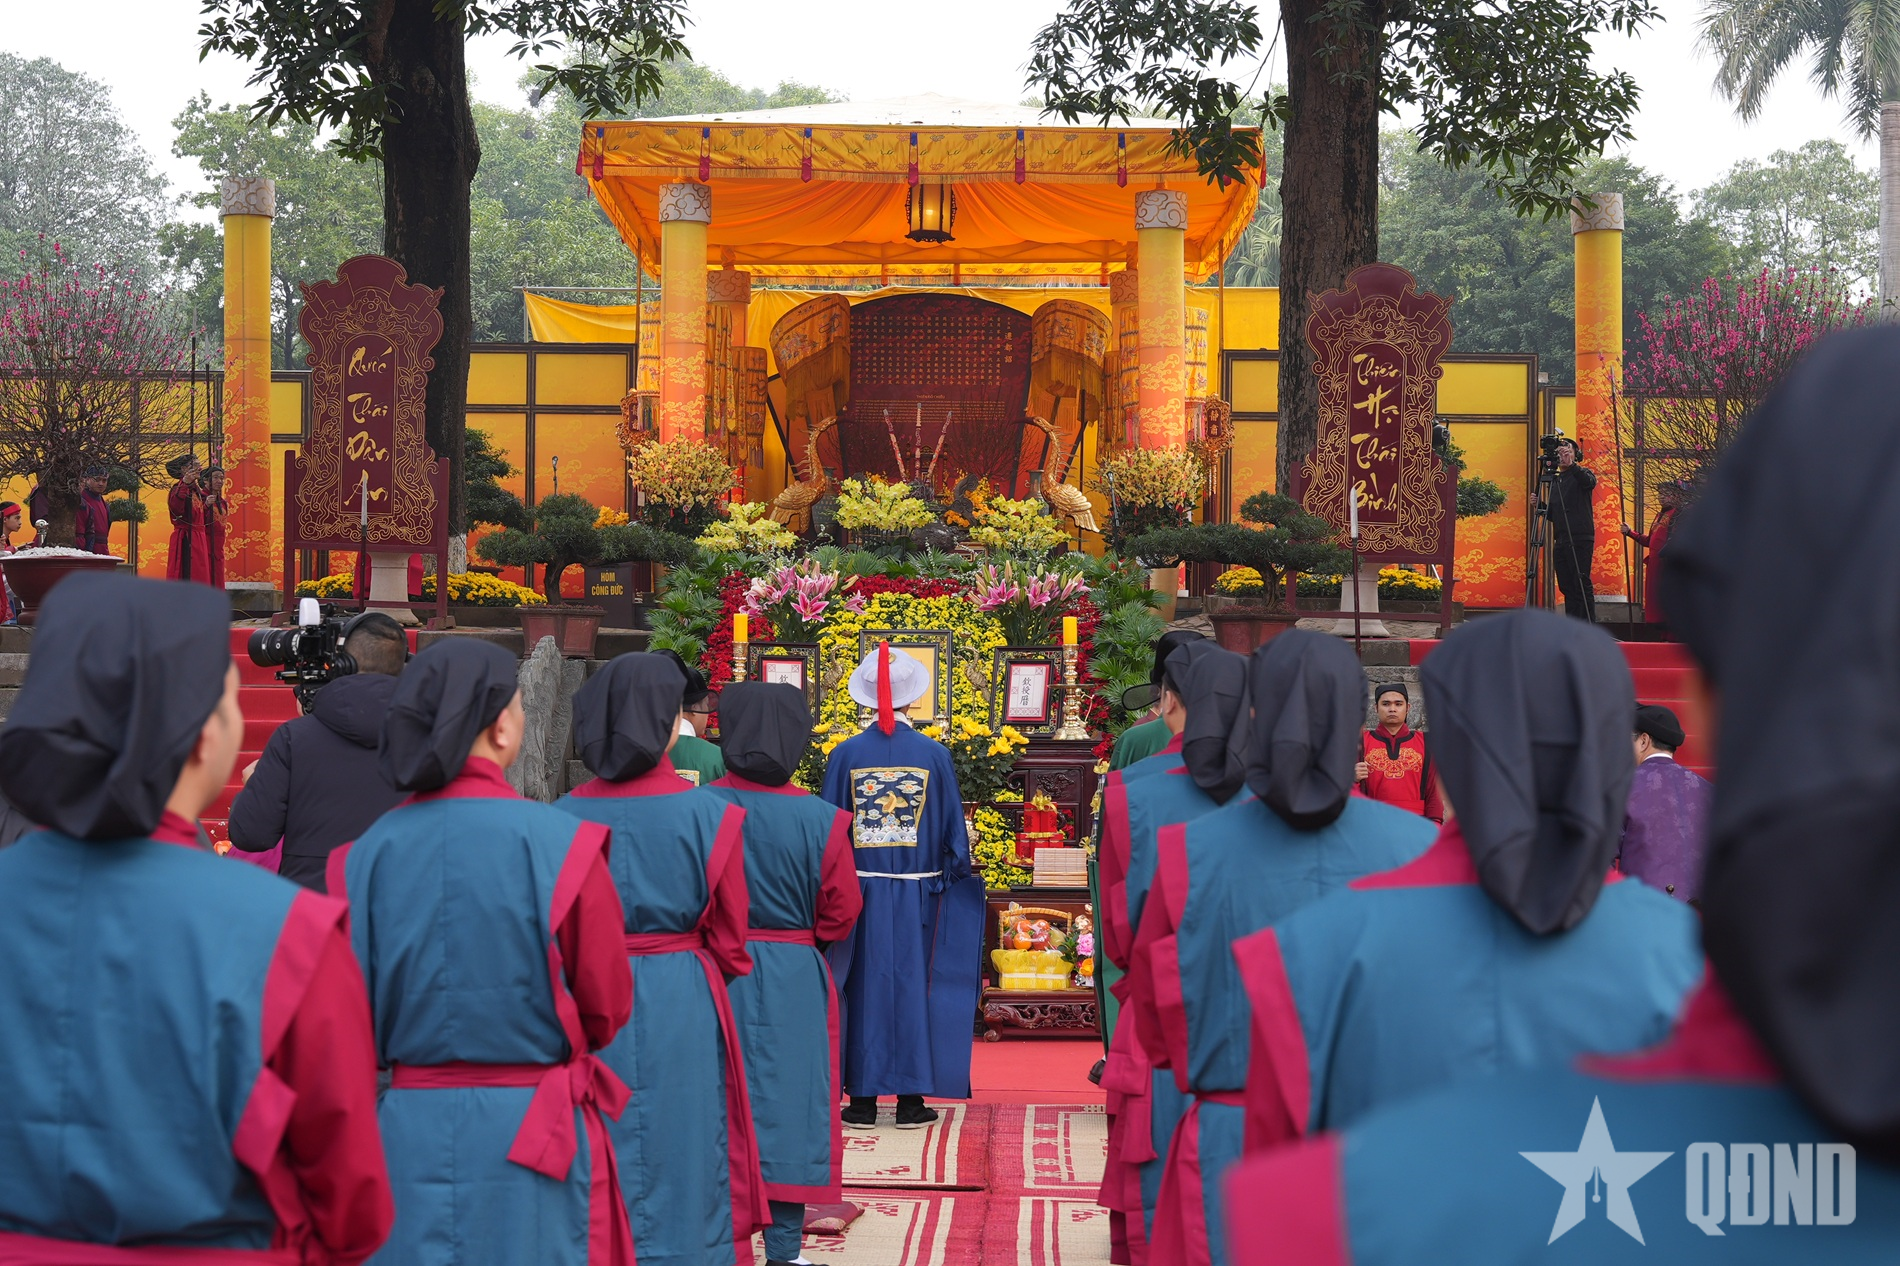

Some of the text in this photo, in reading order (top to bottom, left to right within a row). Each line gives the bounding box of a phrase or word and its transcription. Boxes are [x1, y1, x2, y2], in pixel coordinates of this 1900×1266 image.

[348, 346, 393, 377] Quốc
[1353, 353, 1402, 385] Thiên
[347, 392, 388, 424] Thái
[1353, 384, 1399, 429] Hạ
[345, 430, 390, 462] Dân
[1350, 433, 1398, 469] Thái
[343, 469, 389, 506] An
[1350, 472, 1397, 512] Bình
[591, 583, 624, 596] CÔNG ĐỨC
